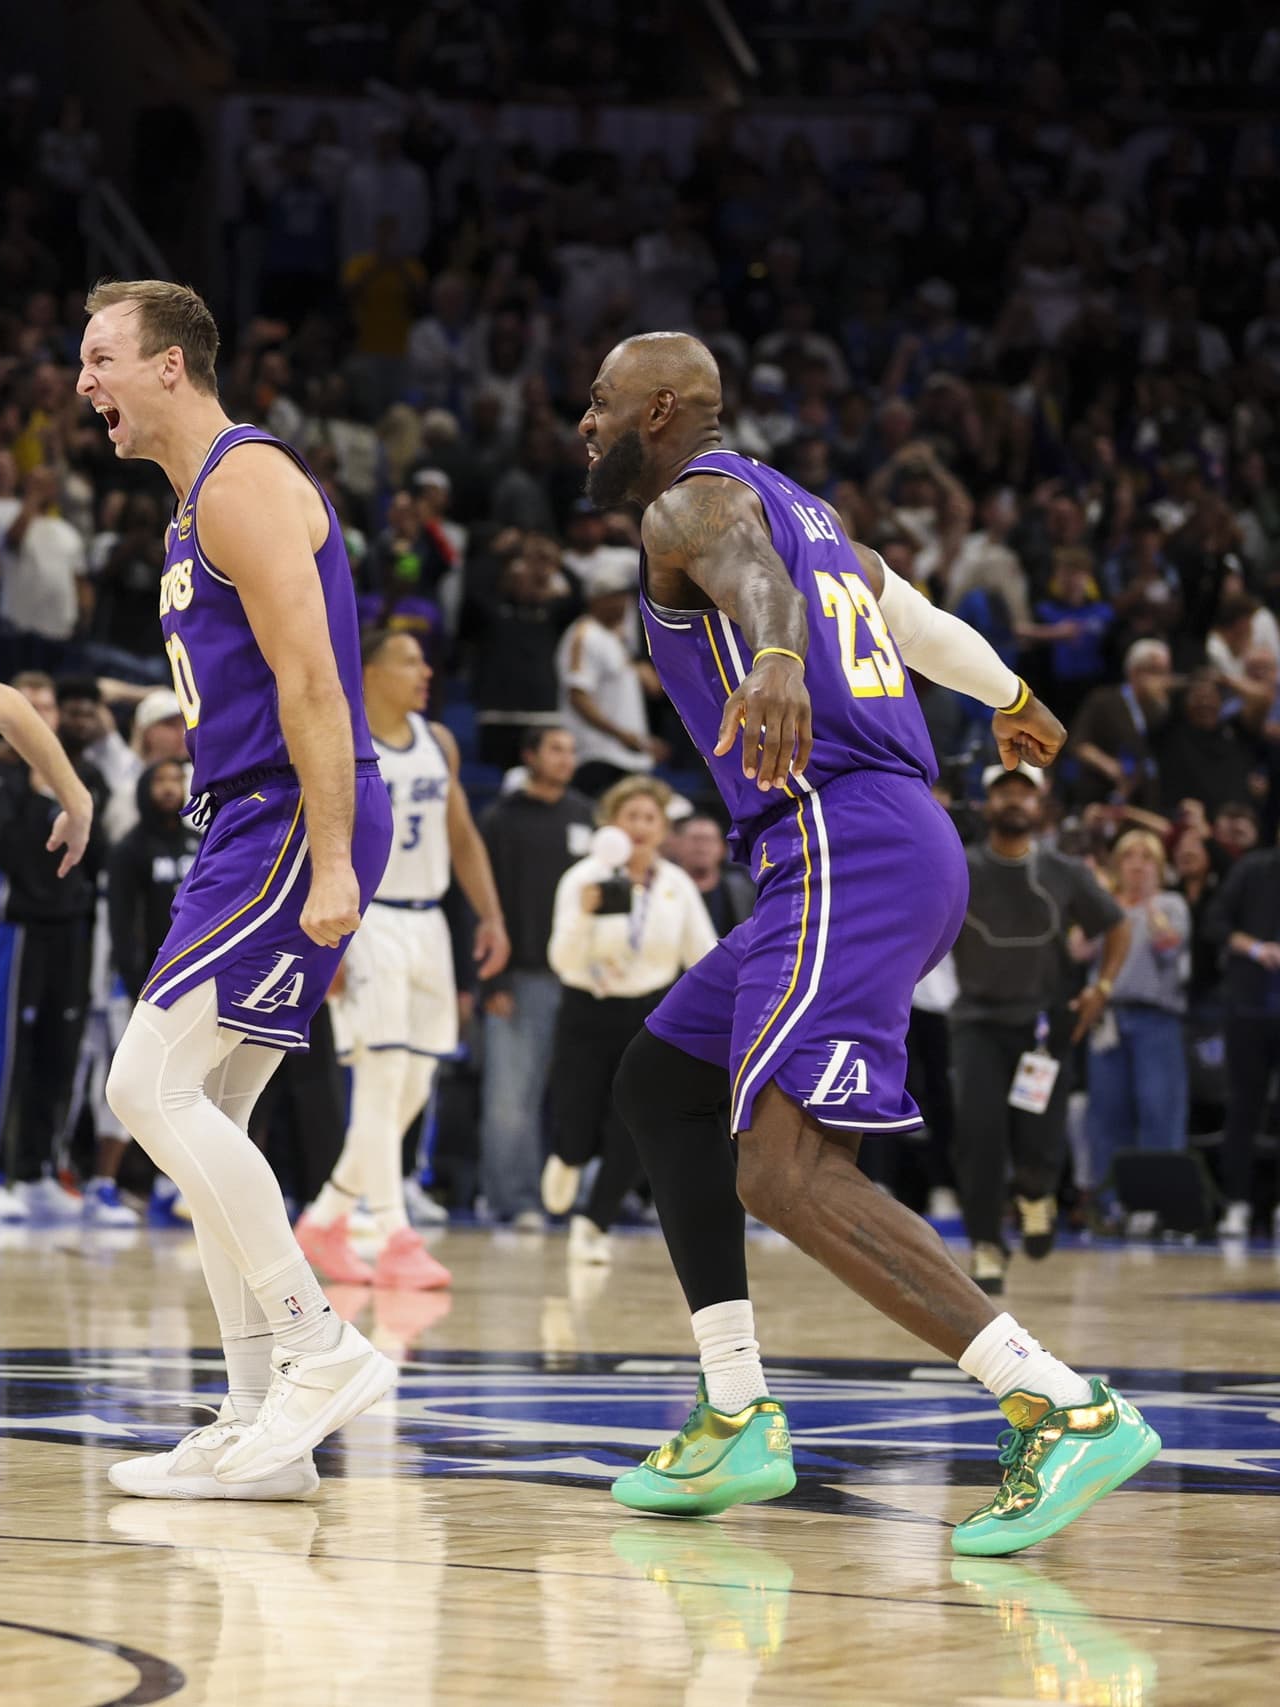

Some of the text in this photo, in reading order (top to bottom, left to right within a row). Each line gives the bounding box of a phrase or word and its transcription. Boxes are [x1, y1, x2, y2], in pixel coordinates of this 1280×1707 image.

[813, 570, 905, 698] 23
[401, 814, 423, 849] 3
[230, 950, 305, 1014] LA
[801, 1040, 871, 1108] LA
